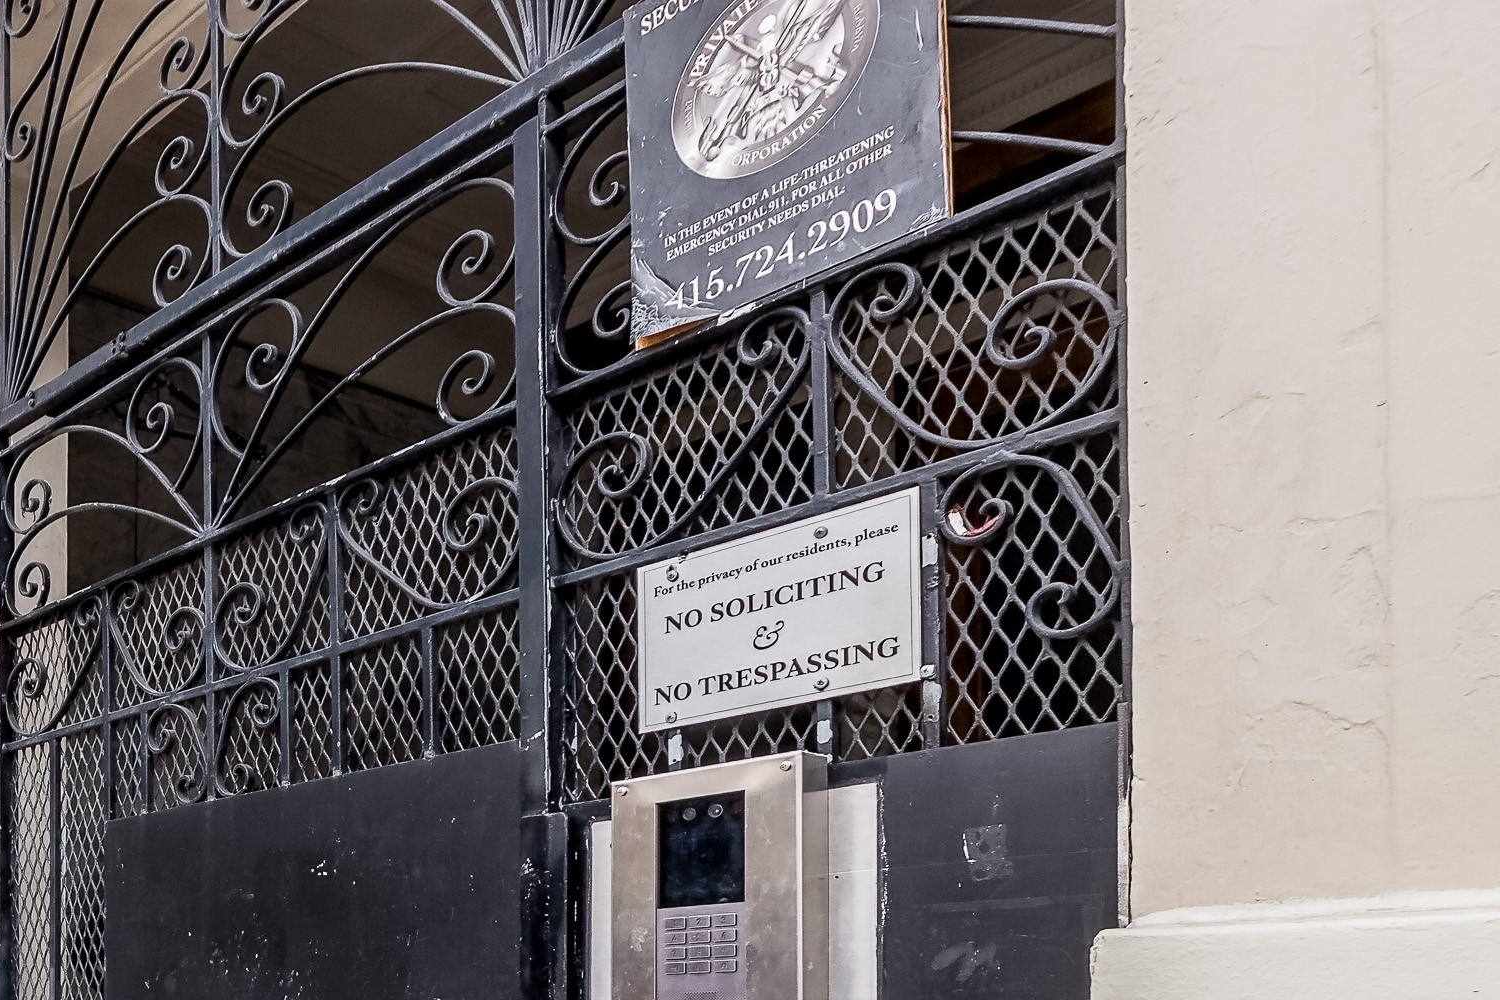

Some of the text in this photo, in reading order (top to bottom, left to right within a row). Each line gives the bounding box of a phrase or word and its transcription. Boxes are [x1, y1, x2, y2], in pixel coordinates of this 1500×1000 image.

[689, 0, 758, 77] PRIVATE
[663, 126, 895, 248] IN THE EVENT OF A LIFE-THREATENING
[666, 222, 735, 262] EMERGENCY
[736, 207, 768, 230] DIAL
[791, 182, 818, 201] FOR
[819, 169, 844, 188] ALL
[846, 144, 893, 175] OTHER
[664, 188, 897, 309] 415.724.2909
[708, 221, 766, 257] SECURITY
[767, 203, 809, 228] NEEDS
[653, 523, 899, 598] For the privacy of our residents, please
[664, 560, 886, 635] NO SOLICITING
[654, 636, 900, 706] NO TRESPASSING
[752, 620, 785, 650] &
